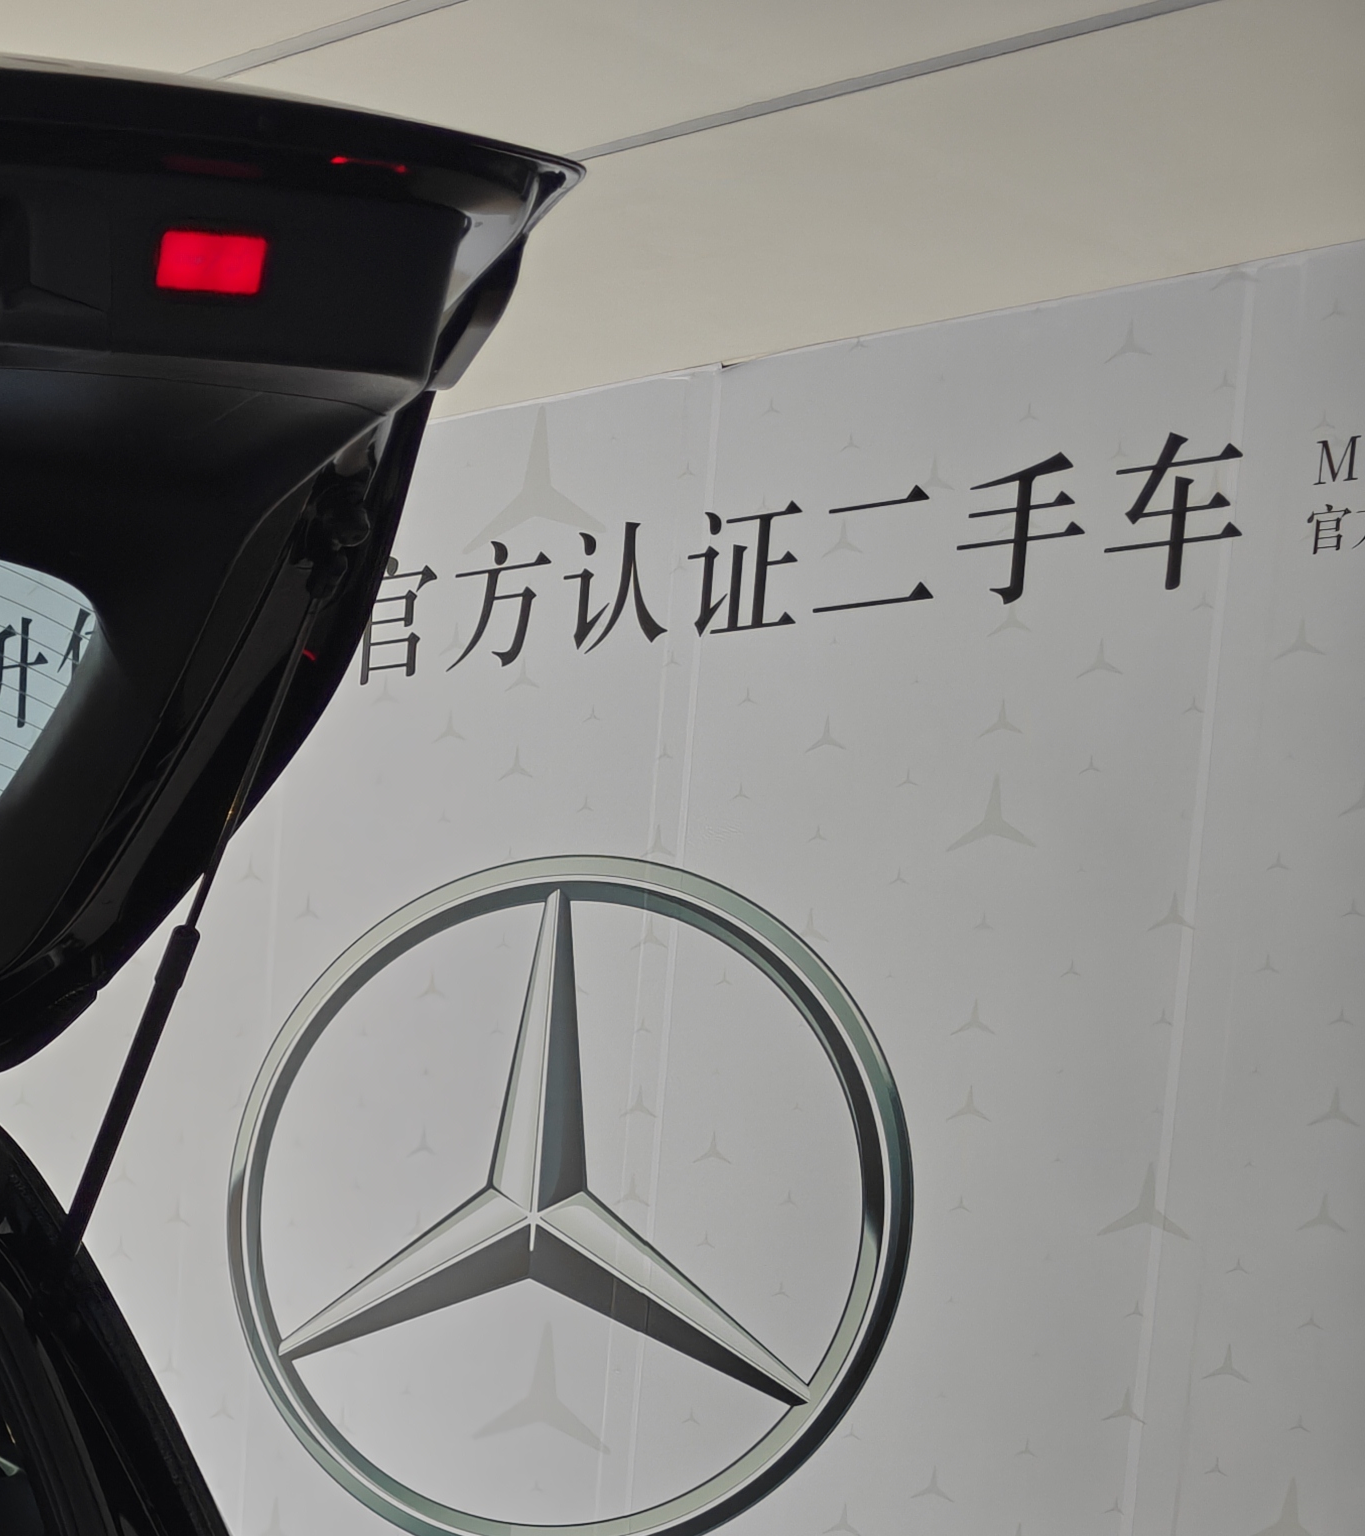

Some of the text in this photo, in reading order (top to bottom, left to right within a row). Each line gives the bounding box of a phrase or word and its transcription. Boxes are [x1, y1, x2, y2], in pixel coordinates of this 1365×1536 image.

[1312, 434, 1363, 486] M
[359, 430, 1244, 686] 官方认证二手车
